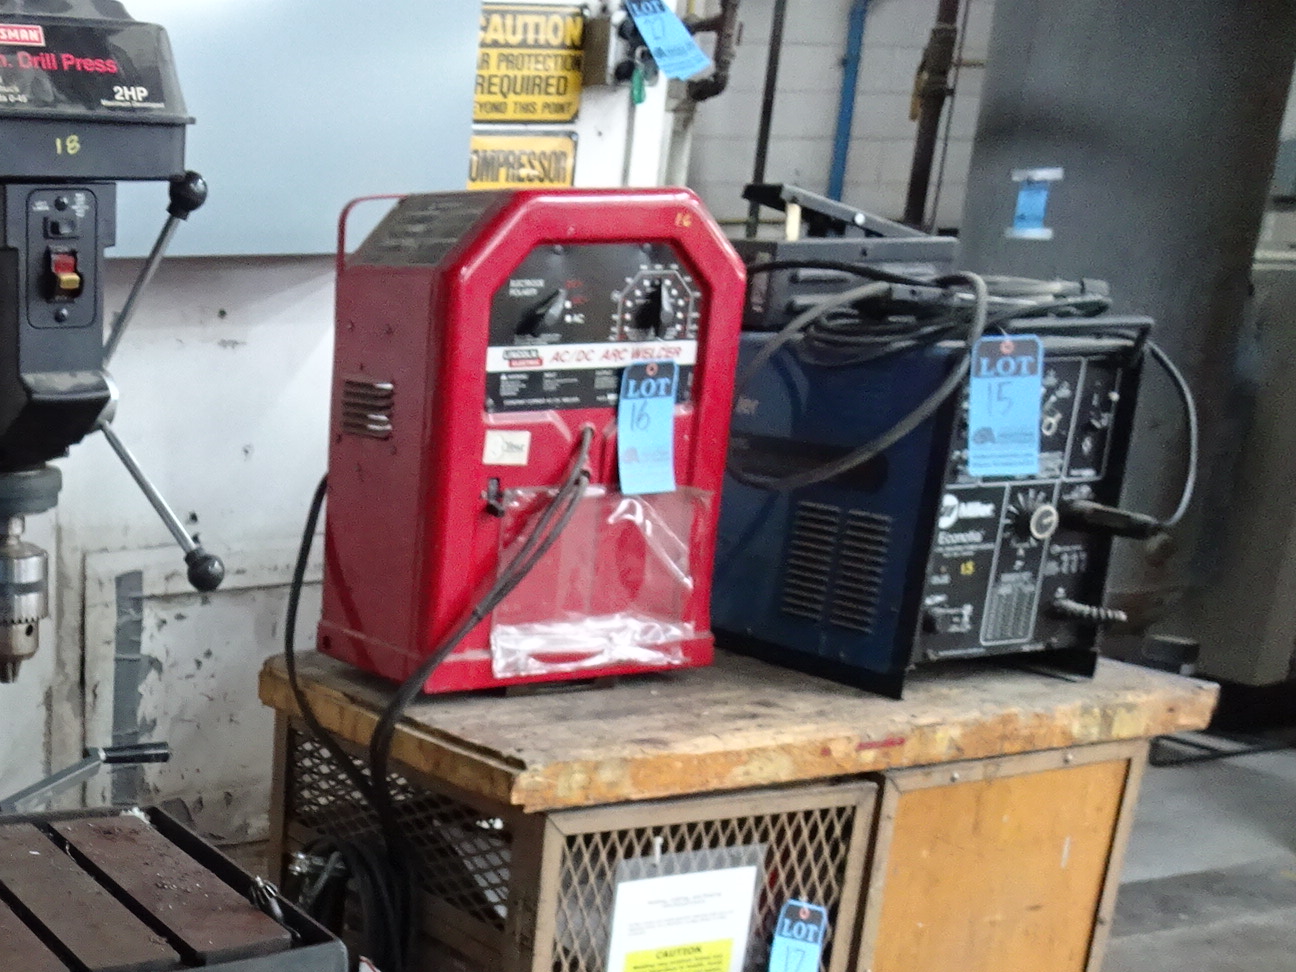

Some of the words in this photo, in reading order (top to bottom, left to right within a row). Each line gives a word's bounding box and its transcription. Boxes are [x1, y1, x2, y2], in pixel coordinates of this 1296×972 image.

[16, 51, 58, 70] Drill
[61, 53, 118, 74] Press
[497, 53, 582, 72] PROTECTION
[112, 85, 149, 101] 2HP
[475, 74, 569, 98] REQUIRED
[513, 101, 538, 114] THIS
[541, 101, 573, 115] POINT
[469, 149, 568, 183] OMPRESSOR
[599, 348, 627, 361] ARC
[630, 346, 683, 360] WELDER
[979, 356, 1035, 376] LOT
[627, 377, 671, 398] LOT
[986, 381, 1013, 417] 15
[630, 400, 651, 431] 16
[782, 918, 819, 942] LOT
